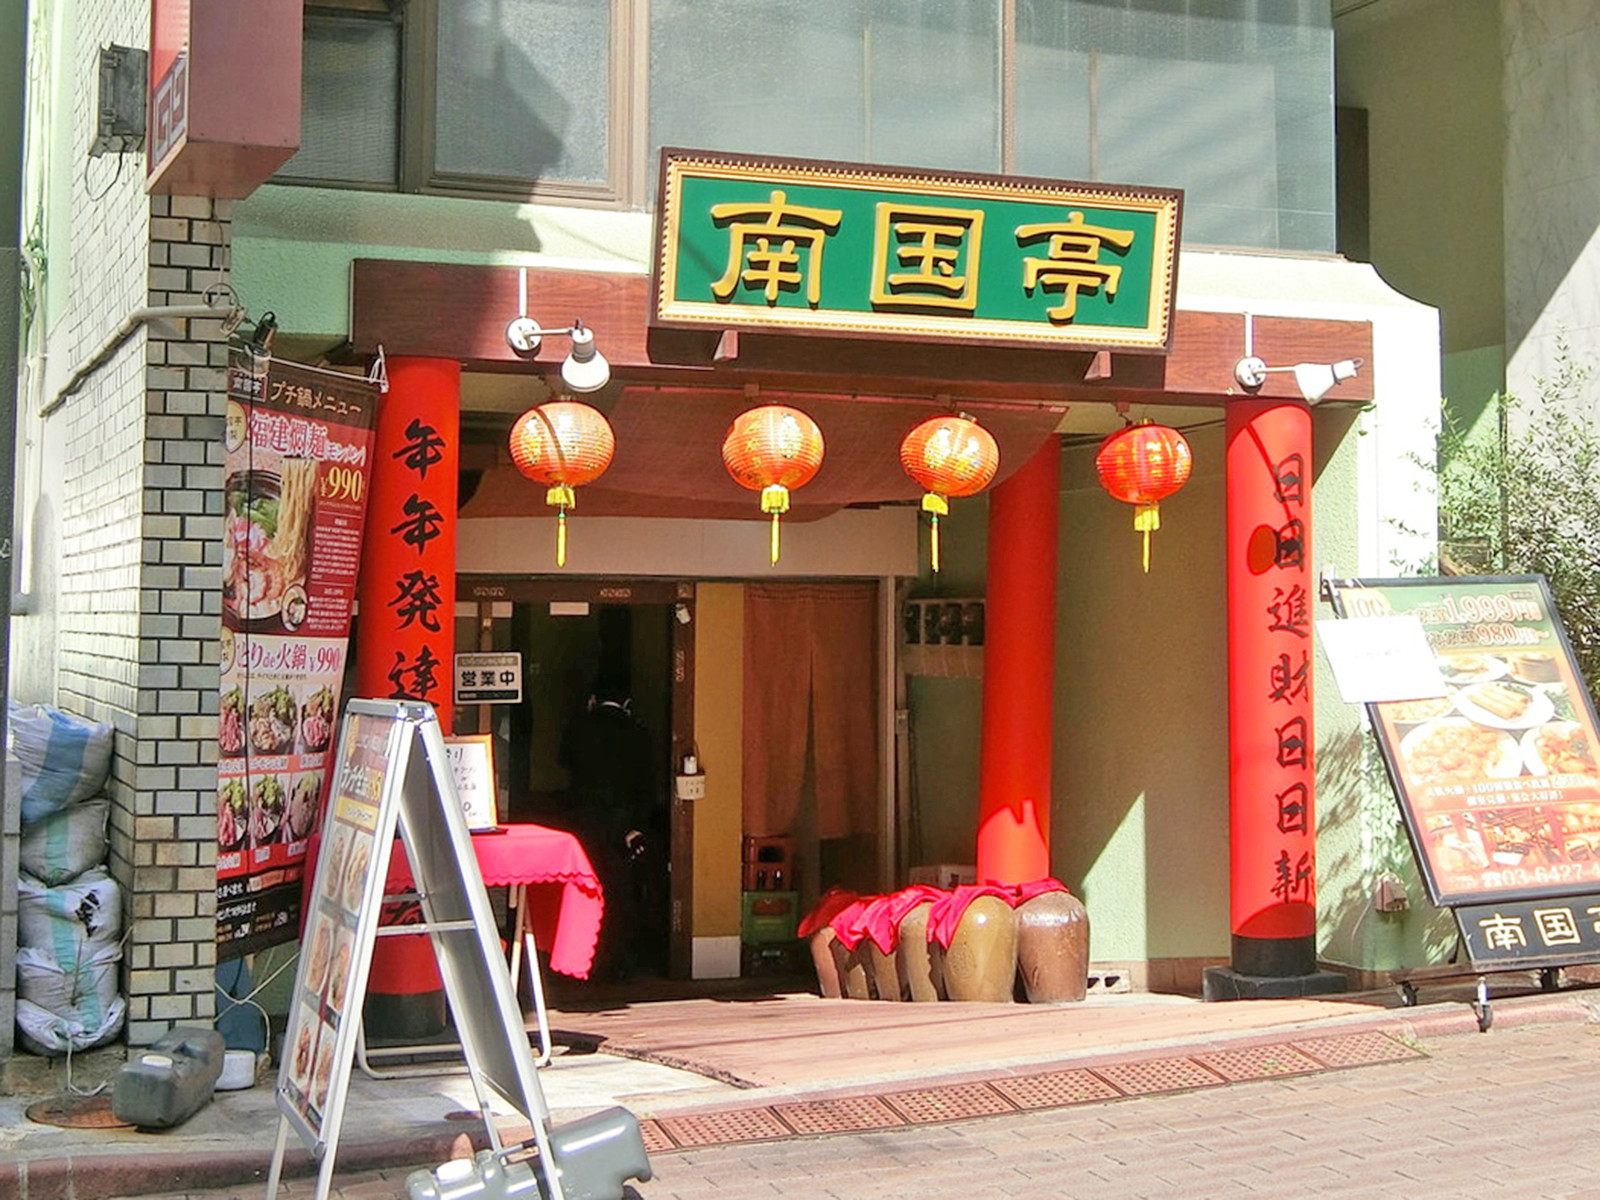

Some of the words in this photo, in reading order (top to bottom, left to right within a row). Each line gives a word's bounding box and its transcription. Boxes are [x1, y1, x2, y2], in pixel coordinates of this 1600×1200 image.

[710, 189, 1135, 320] 南国亭
[270, 380, 362, 415] プチ鍋メニュー
[461, 670, 515, 688] 営業中
